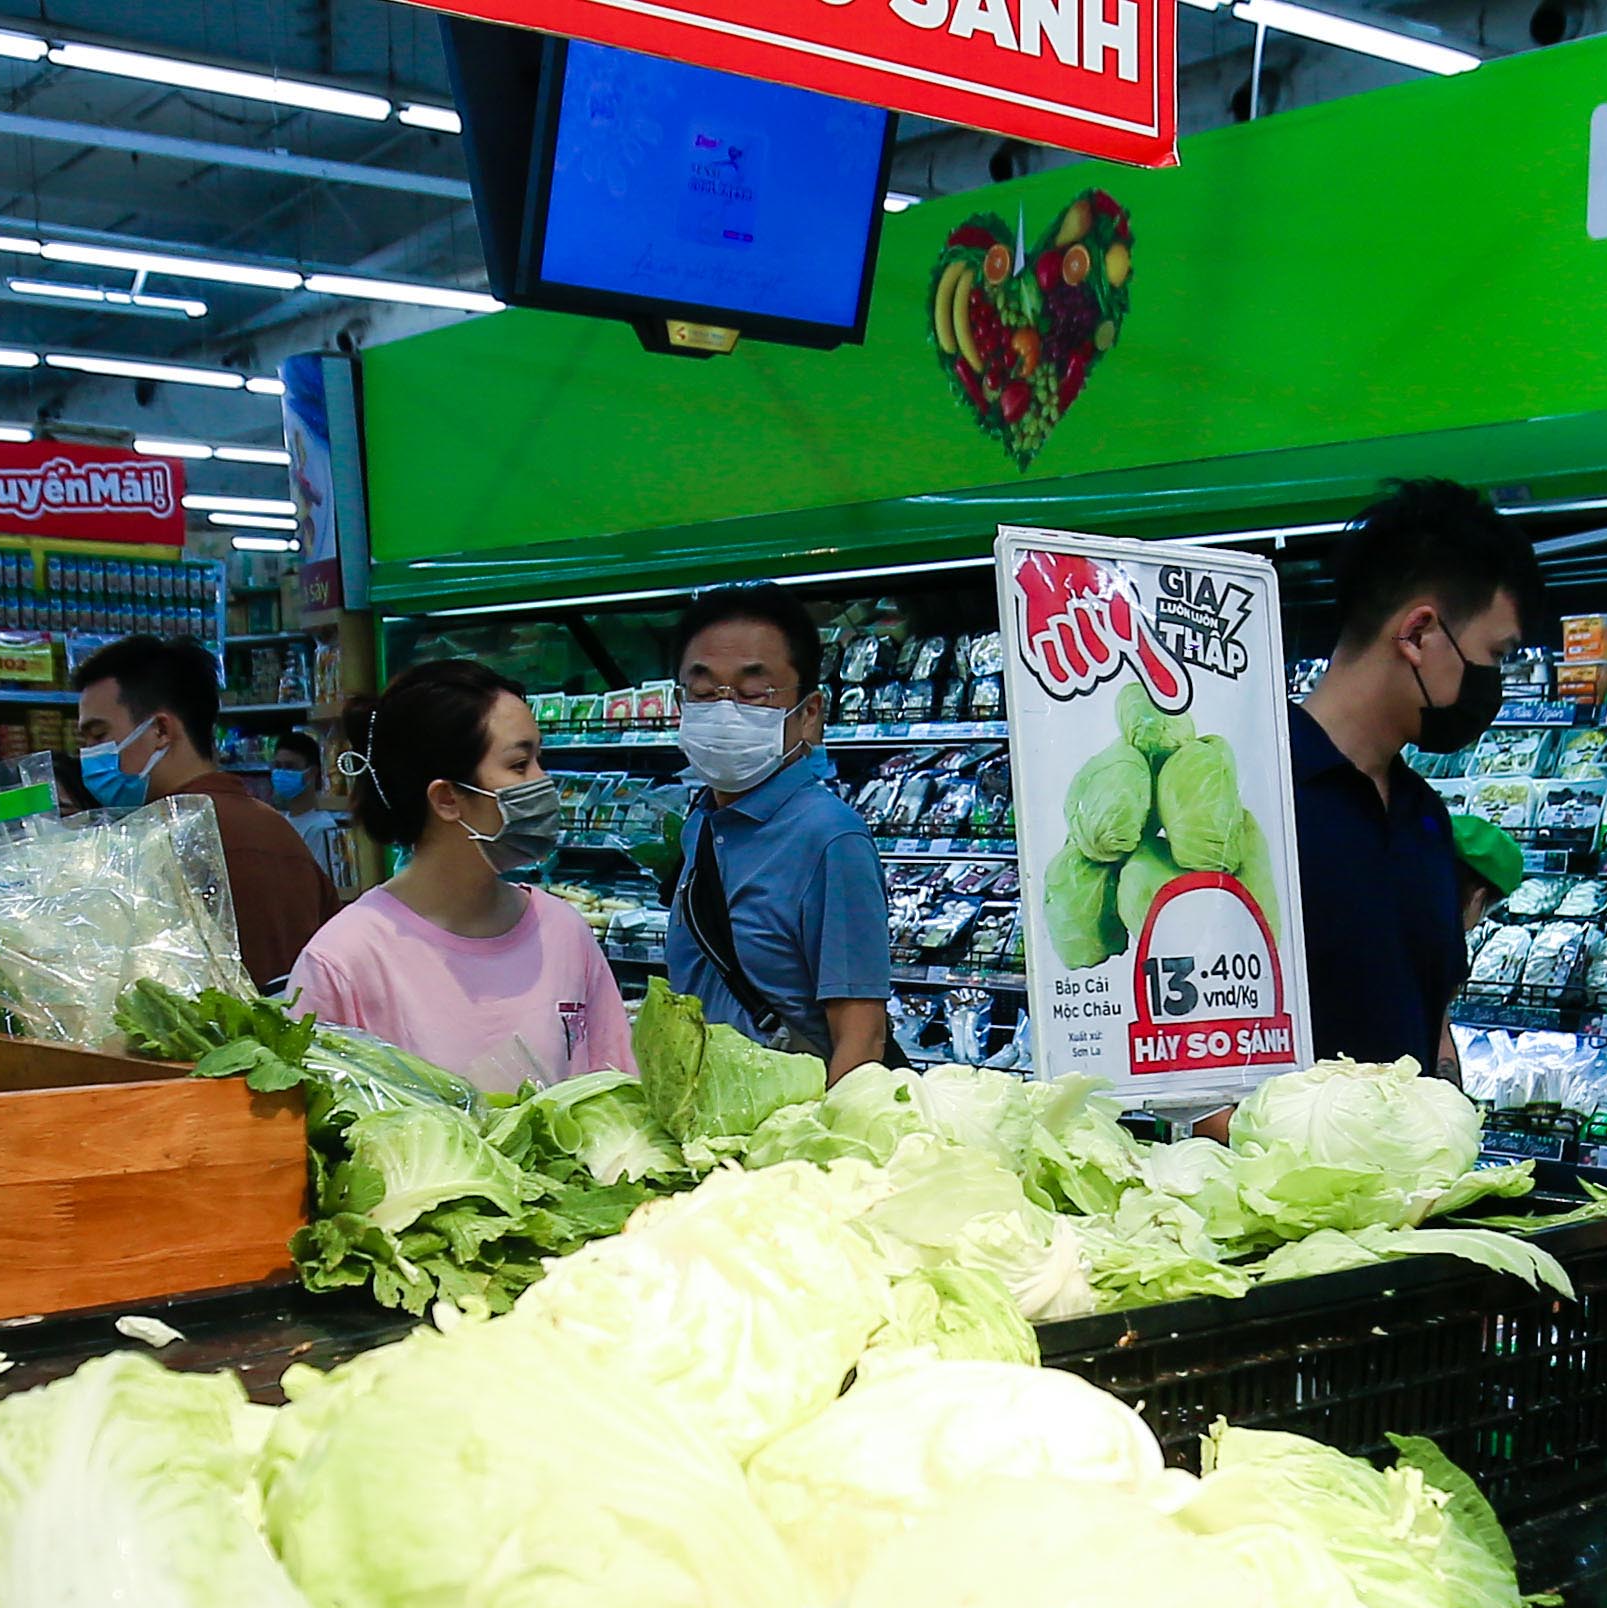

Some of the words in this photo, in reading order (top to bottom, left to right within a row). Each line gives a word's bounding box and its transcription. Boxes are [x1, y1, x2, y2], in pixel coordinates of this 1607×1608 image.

[1158, 564, 1221, 606] GIÁ
[1084, 976, 1109, 994] Cải
[1143, 956, 1199, 1017] 13
[1203, 985, 1259, 1010] vnd/Kg
[1186, 1030, 1232, 1059] SO
[1236, 1022, 1291, 1056] SÁNH
